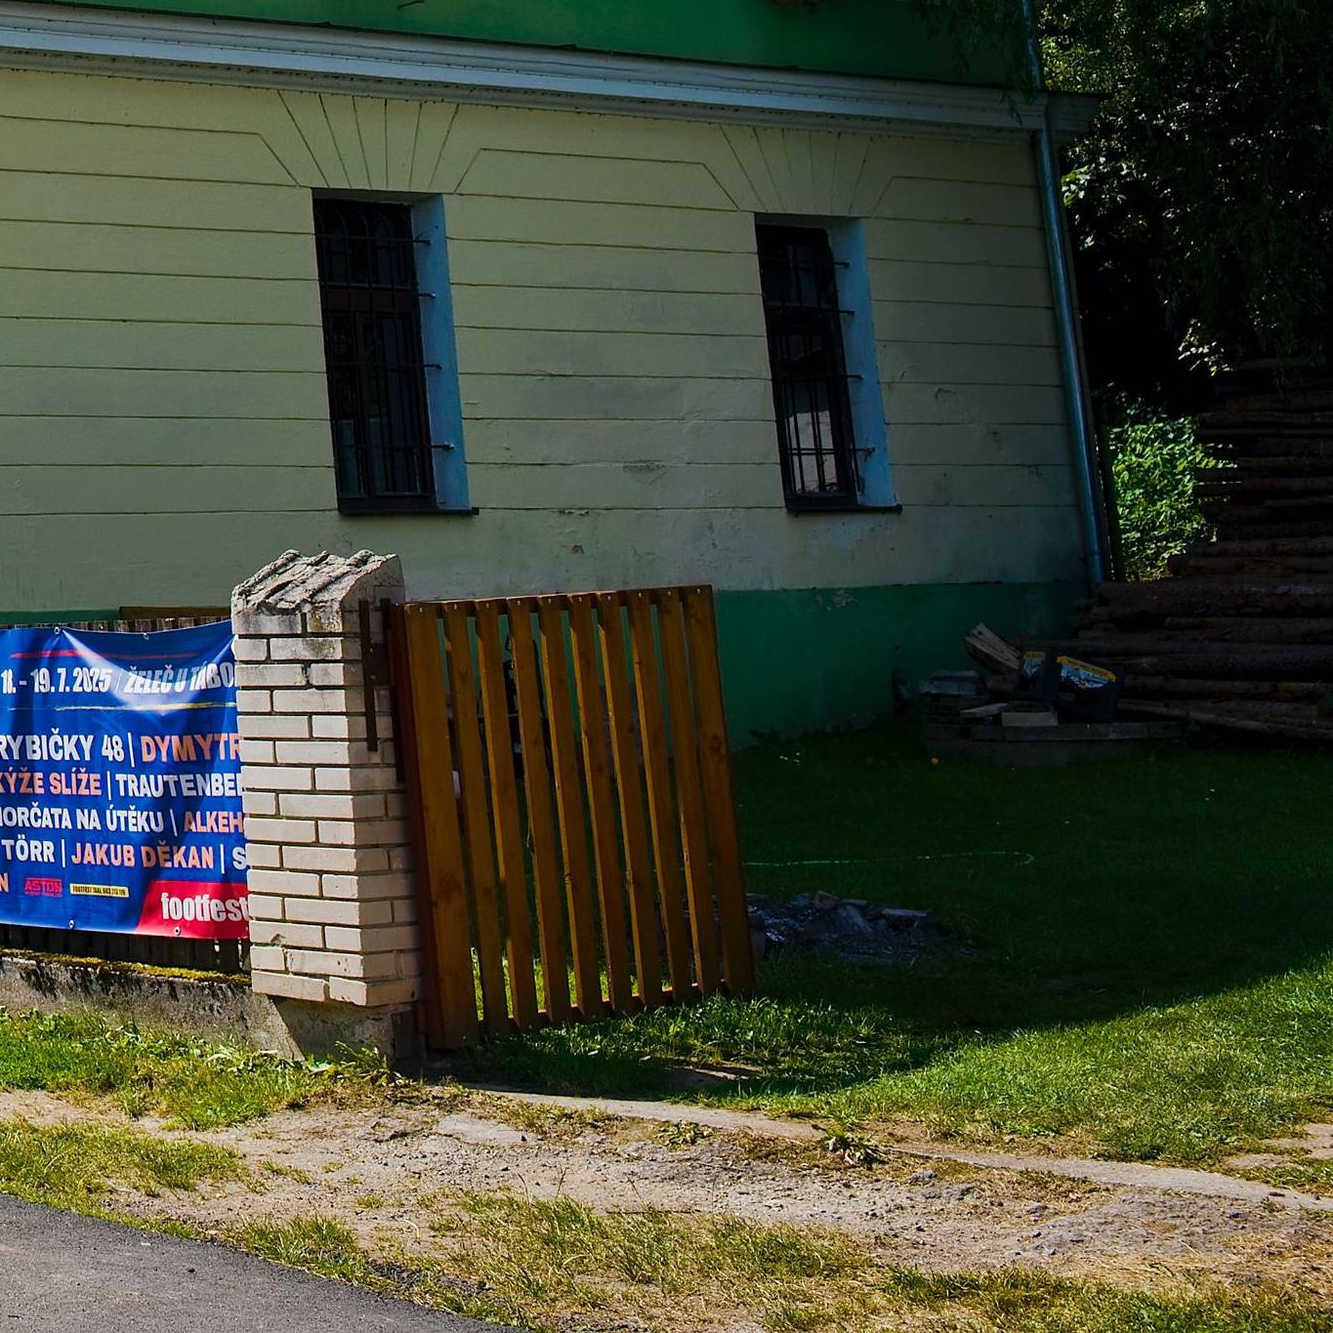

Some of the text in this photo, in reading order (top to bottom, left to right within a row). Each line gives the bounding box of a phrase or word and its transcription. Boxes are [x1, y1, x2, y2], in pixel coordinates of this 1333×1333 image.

[123, 665, 173, 694] ŽELEČ
[174, 667, 188, 693] U
[188, 661, 237, 691] TÁBO
[101, 732, 125, 762] 48
[49, 768, 102, 796] SLÍŽE
[76, 808, 102, 831] NA
[105, 805, 165, 833] ÚTĚKU
[1, 835, 56, 863] TÖRR
[71, 842, 136, 867] JAKUB
[140, 840, 214, 869] DĚKAN
